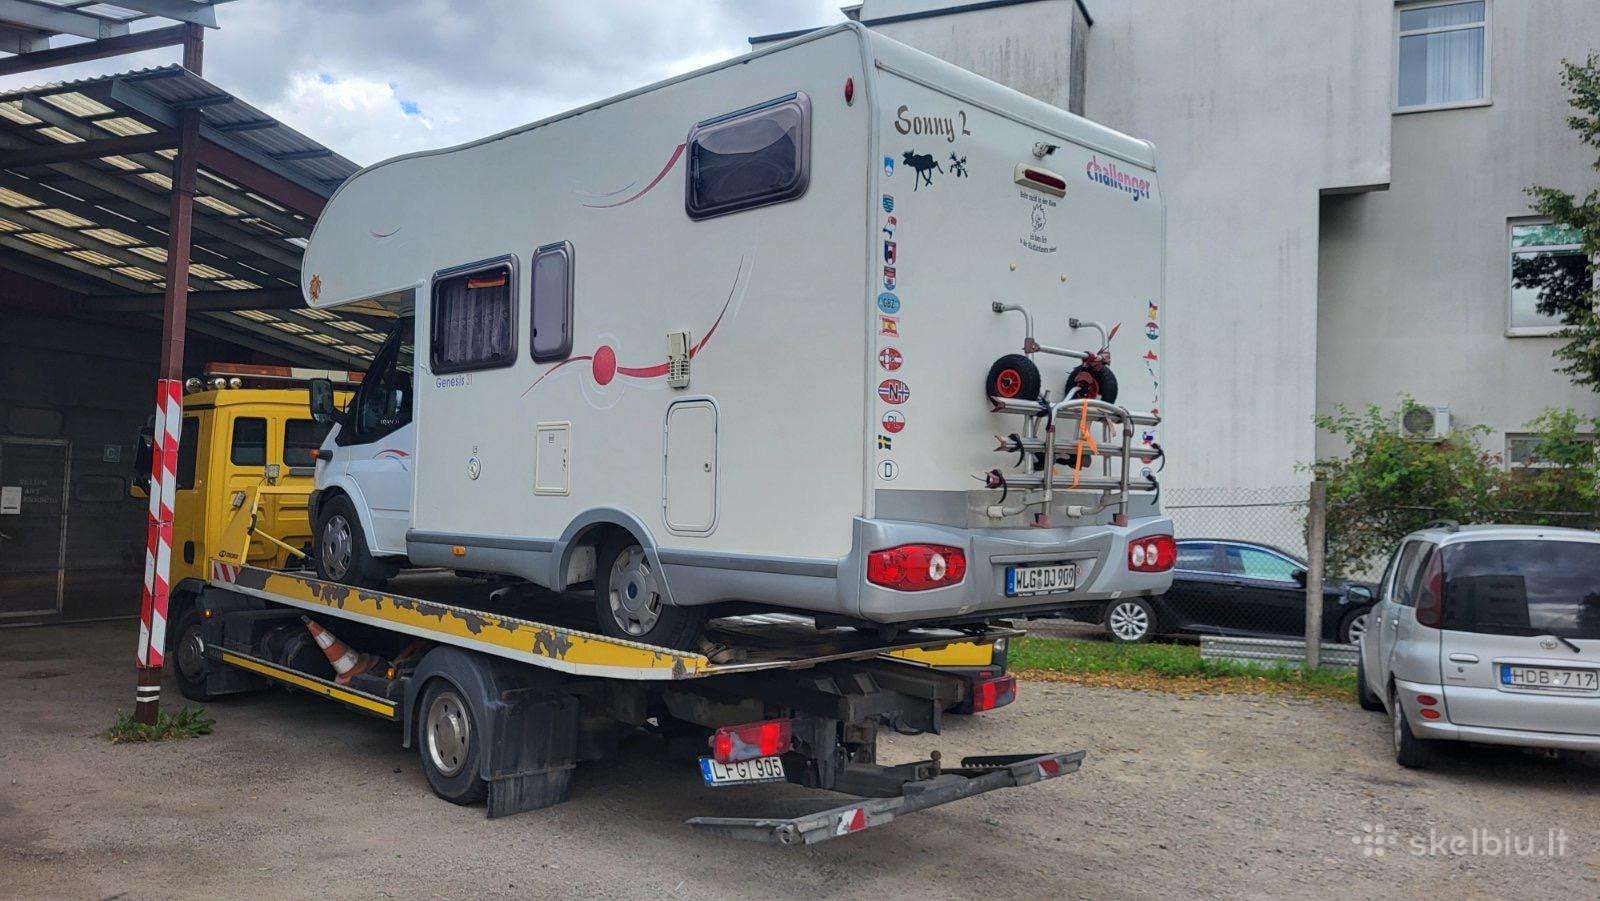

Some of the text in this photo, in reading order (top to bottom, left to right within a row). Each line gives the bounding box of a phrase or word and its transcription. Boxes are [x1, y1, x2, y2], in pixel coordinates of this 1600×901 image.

[895, 104, 971, 143] Sonny 2
[1086, 155, 1151, 202] challenger
[435, 375, 465, 389] Genesis
[889, 384, 899, 400] N
[884, 462, 893, 478] D
[1513, 669, 1594, 687] HDB 717
[755, 758, 782, 777] 905
